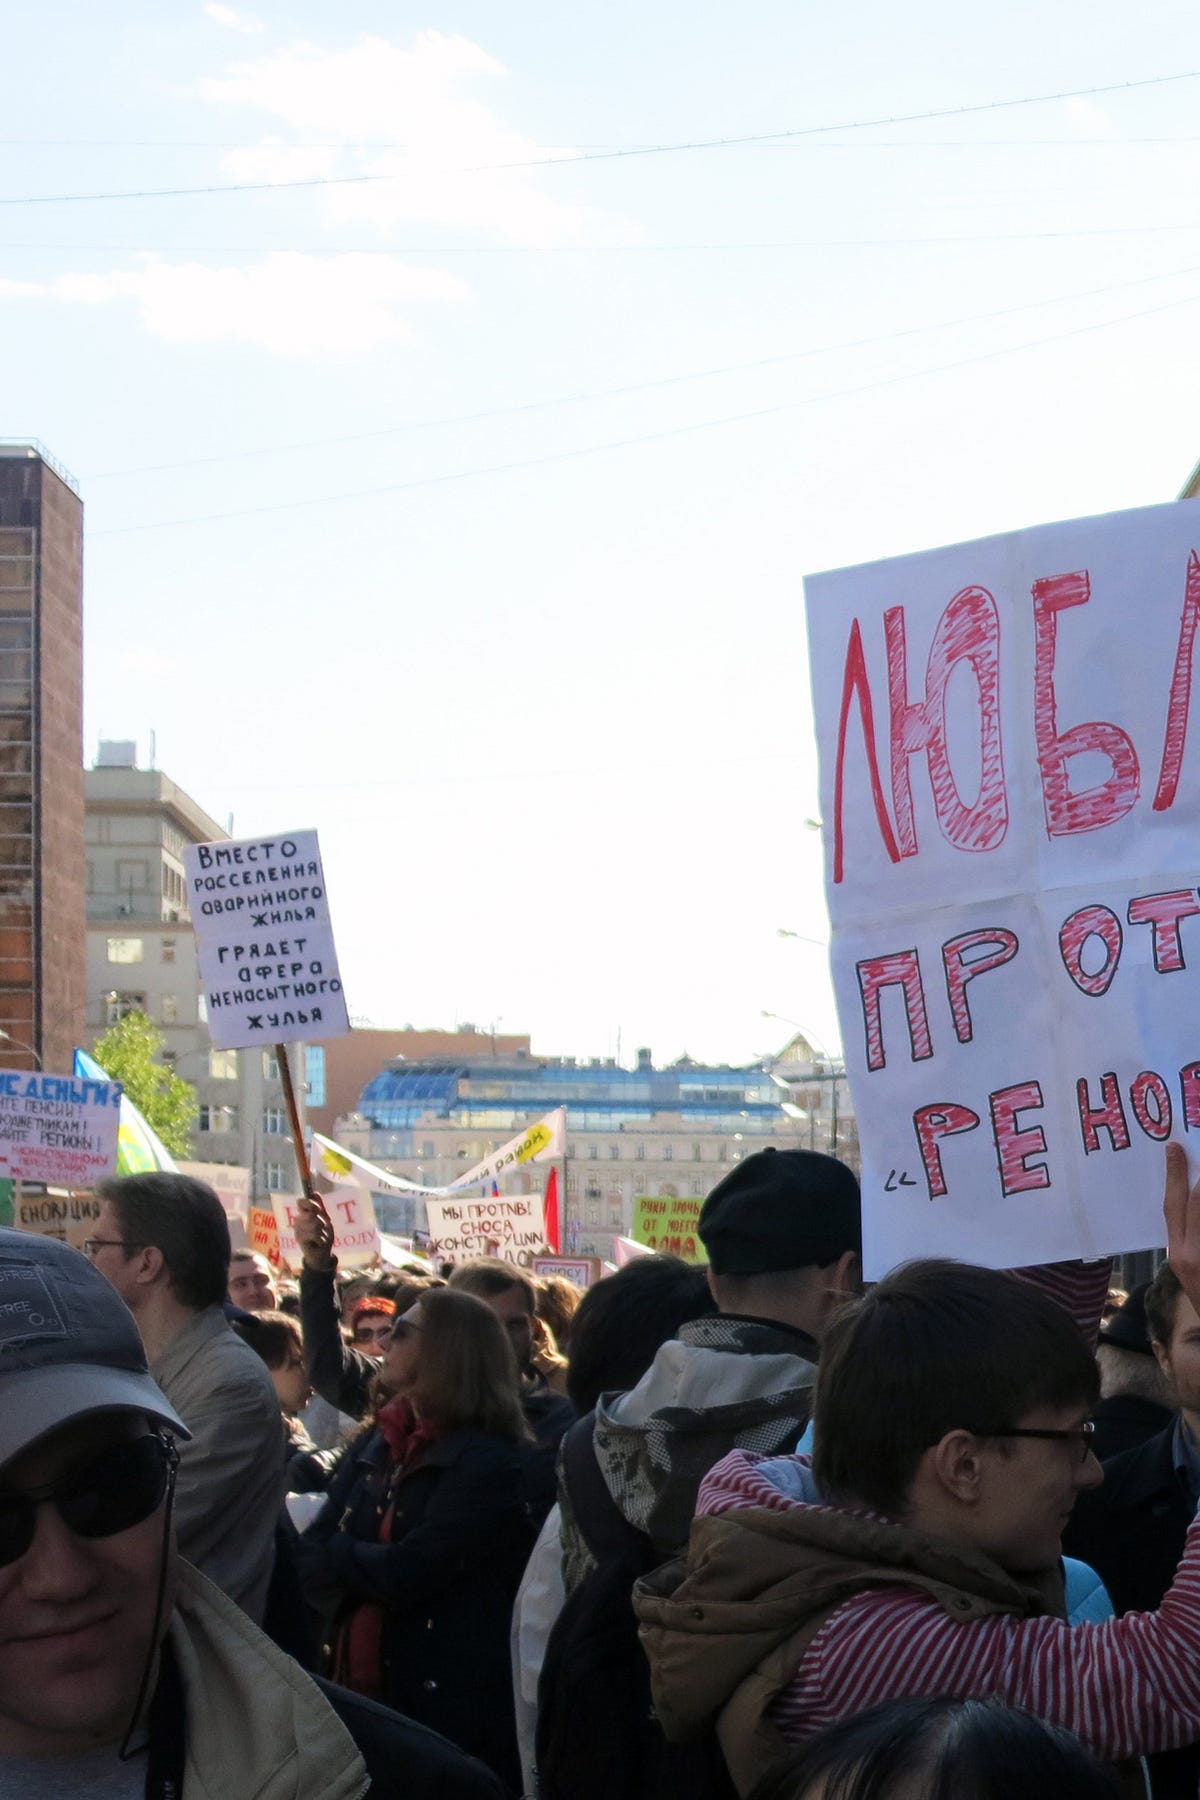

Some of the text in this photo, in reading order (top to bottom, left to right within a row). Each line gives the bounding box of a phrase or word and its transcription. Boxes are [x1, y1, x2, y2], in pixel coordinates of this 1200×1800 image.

[198, 841, 297, 869] ВМЕСТО
[250, 907, 316, 927] ЖИЛЬЯ
[210, 979, 341, 1008] НЕНАСЫТНОГО
[247, 1008, 322, 1030] ЖУЛЬЯ
[442, 1206, 462, 1219] МЫ
[460, 1219, 513, 1235] СНОСА
[643, 1219, 657, 1232] ОТ
